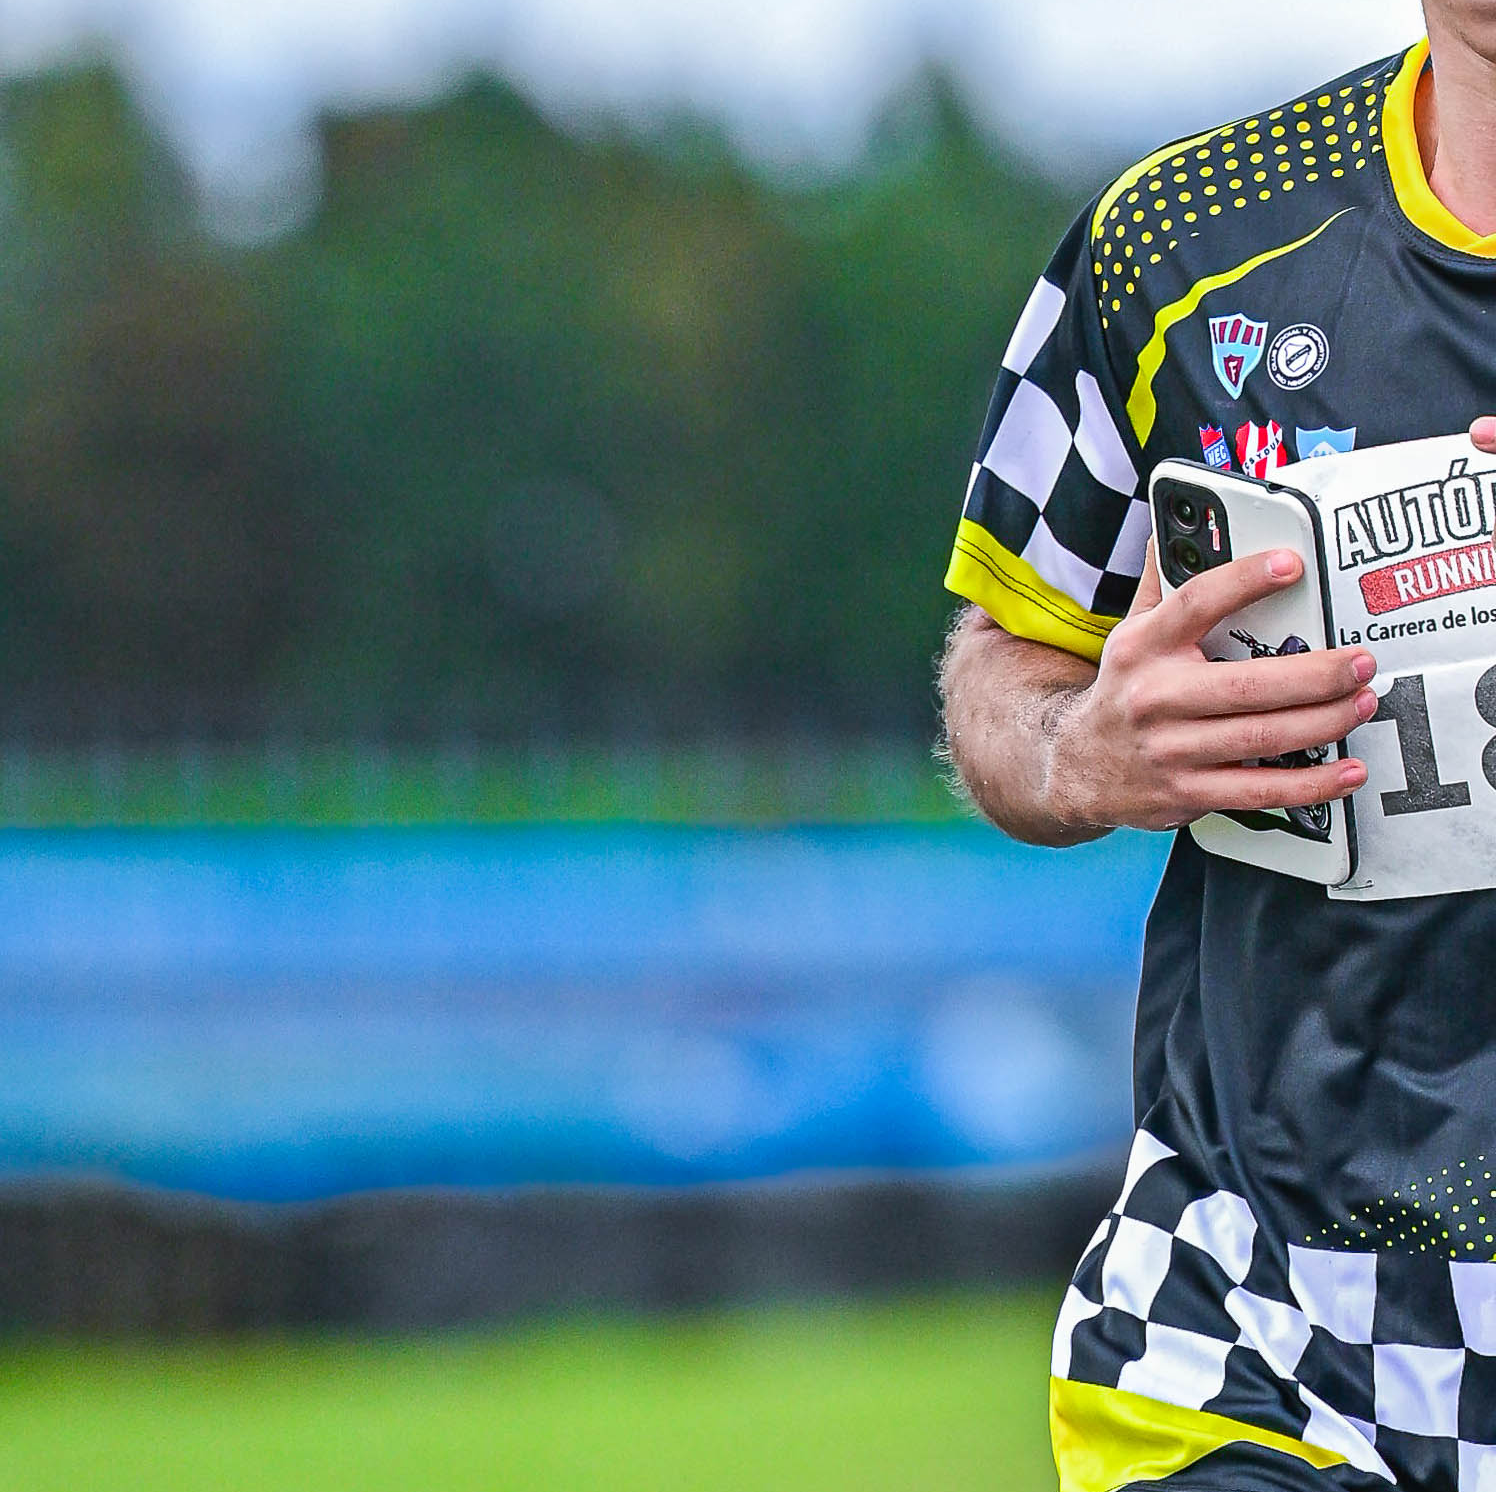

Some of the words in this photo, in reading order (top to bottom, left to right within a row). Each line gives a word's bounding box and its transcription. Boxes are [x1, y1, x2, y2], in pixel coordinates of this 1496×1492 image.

[1340, 628, 1361, 647] La
[1366, 616, 1438, 642] Carrera
[1442, 609, 1467, 630] de
